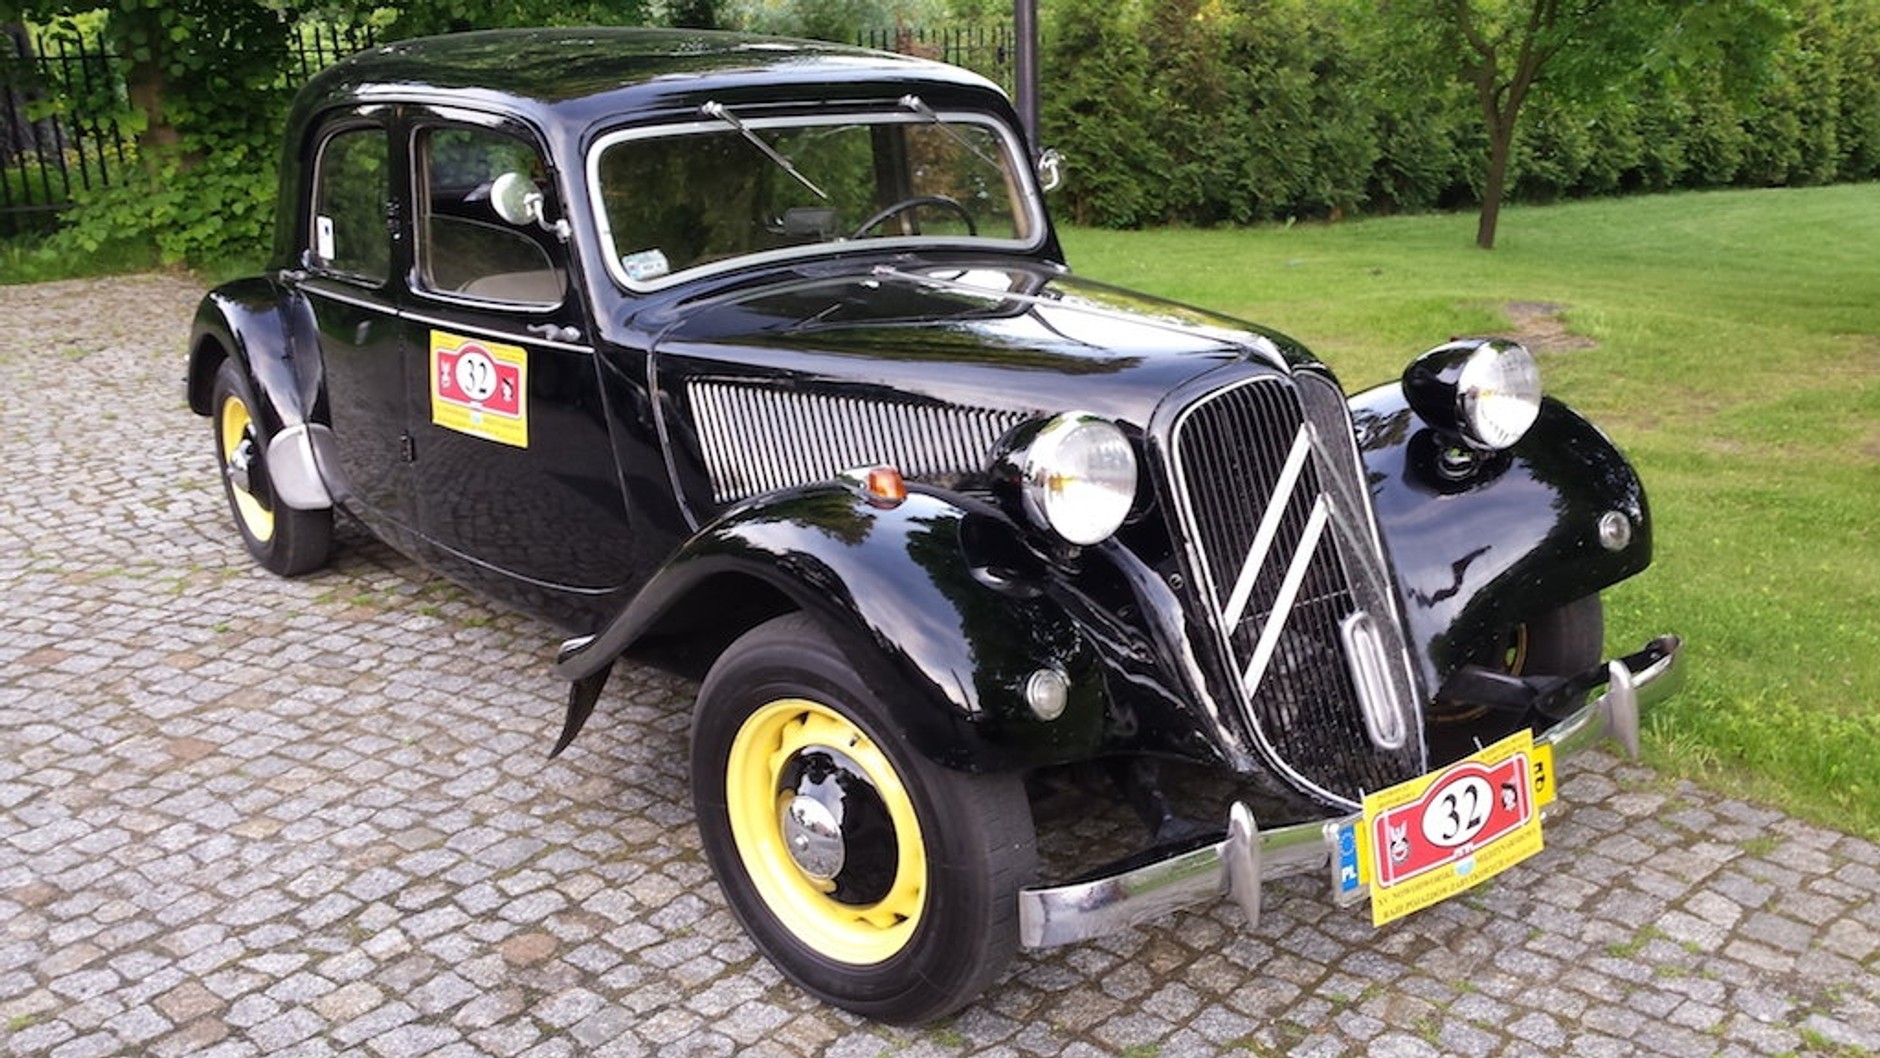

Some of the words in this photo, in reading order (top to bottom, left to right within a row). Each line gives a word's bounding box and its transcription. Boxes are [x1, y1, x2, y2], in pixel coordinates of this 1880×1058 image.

[465, 359, 488, 394] 32
[1441, 784, 1482, 840] 32
[1342, 864, 1358, 883] PL
